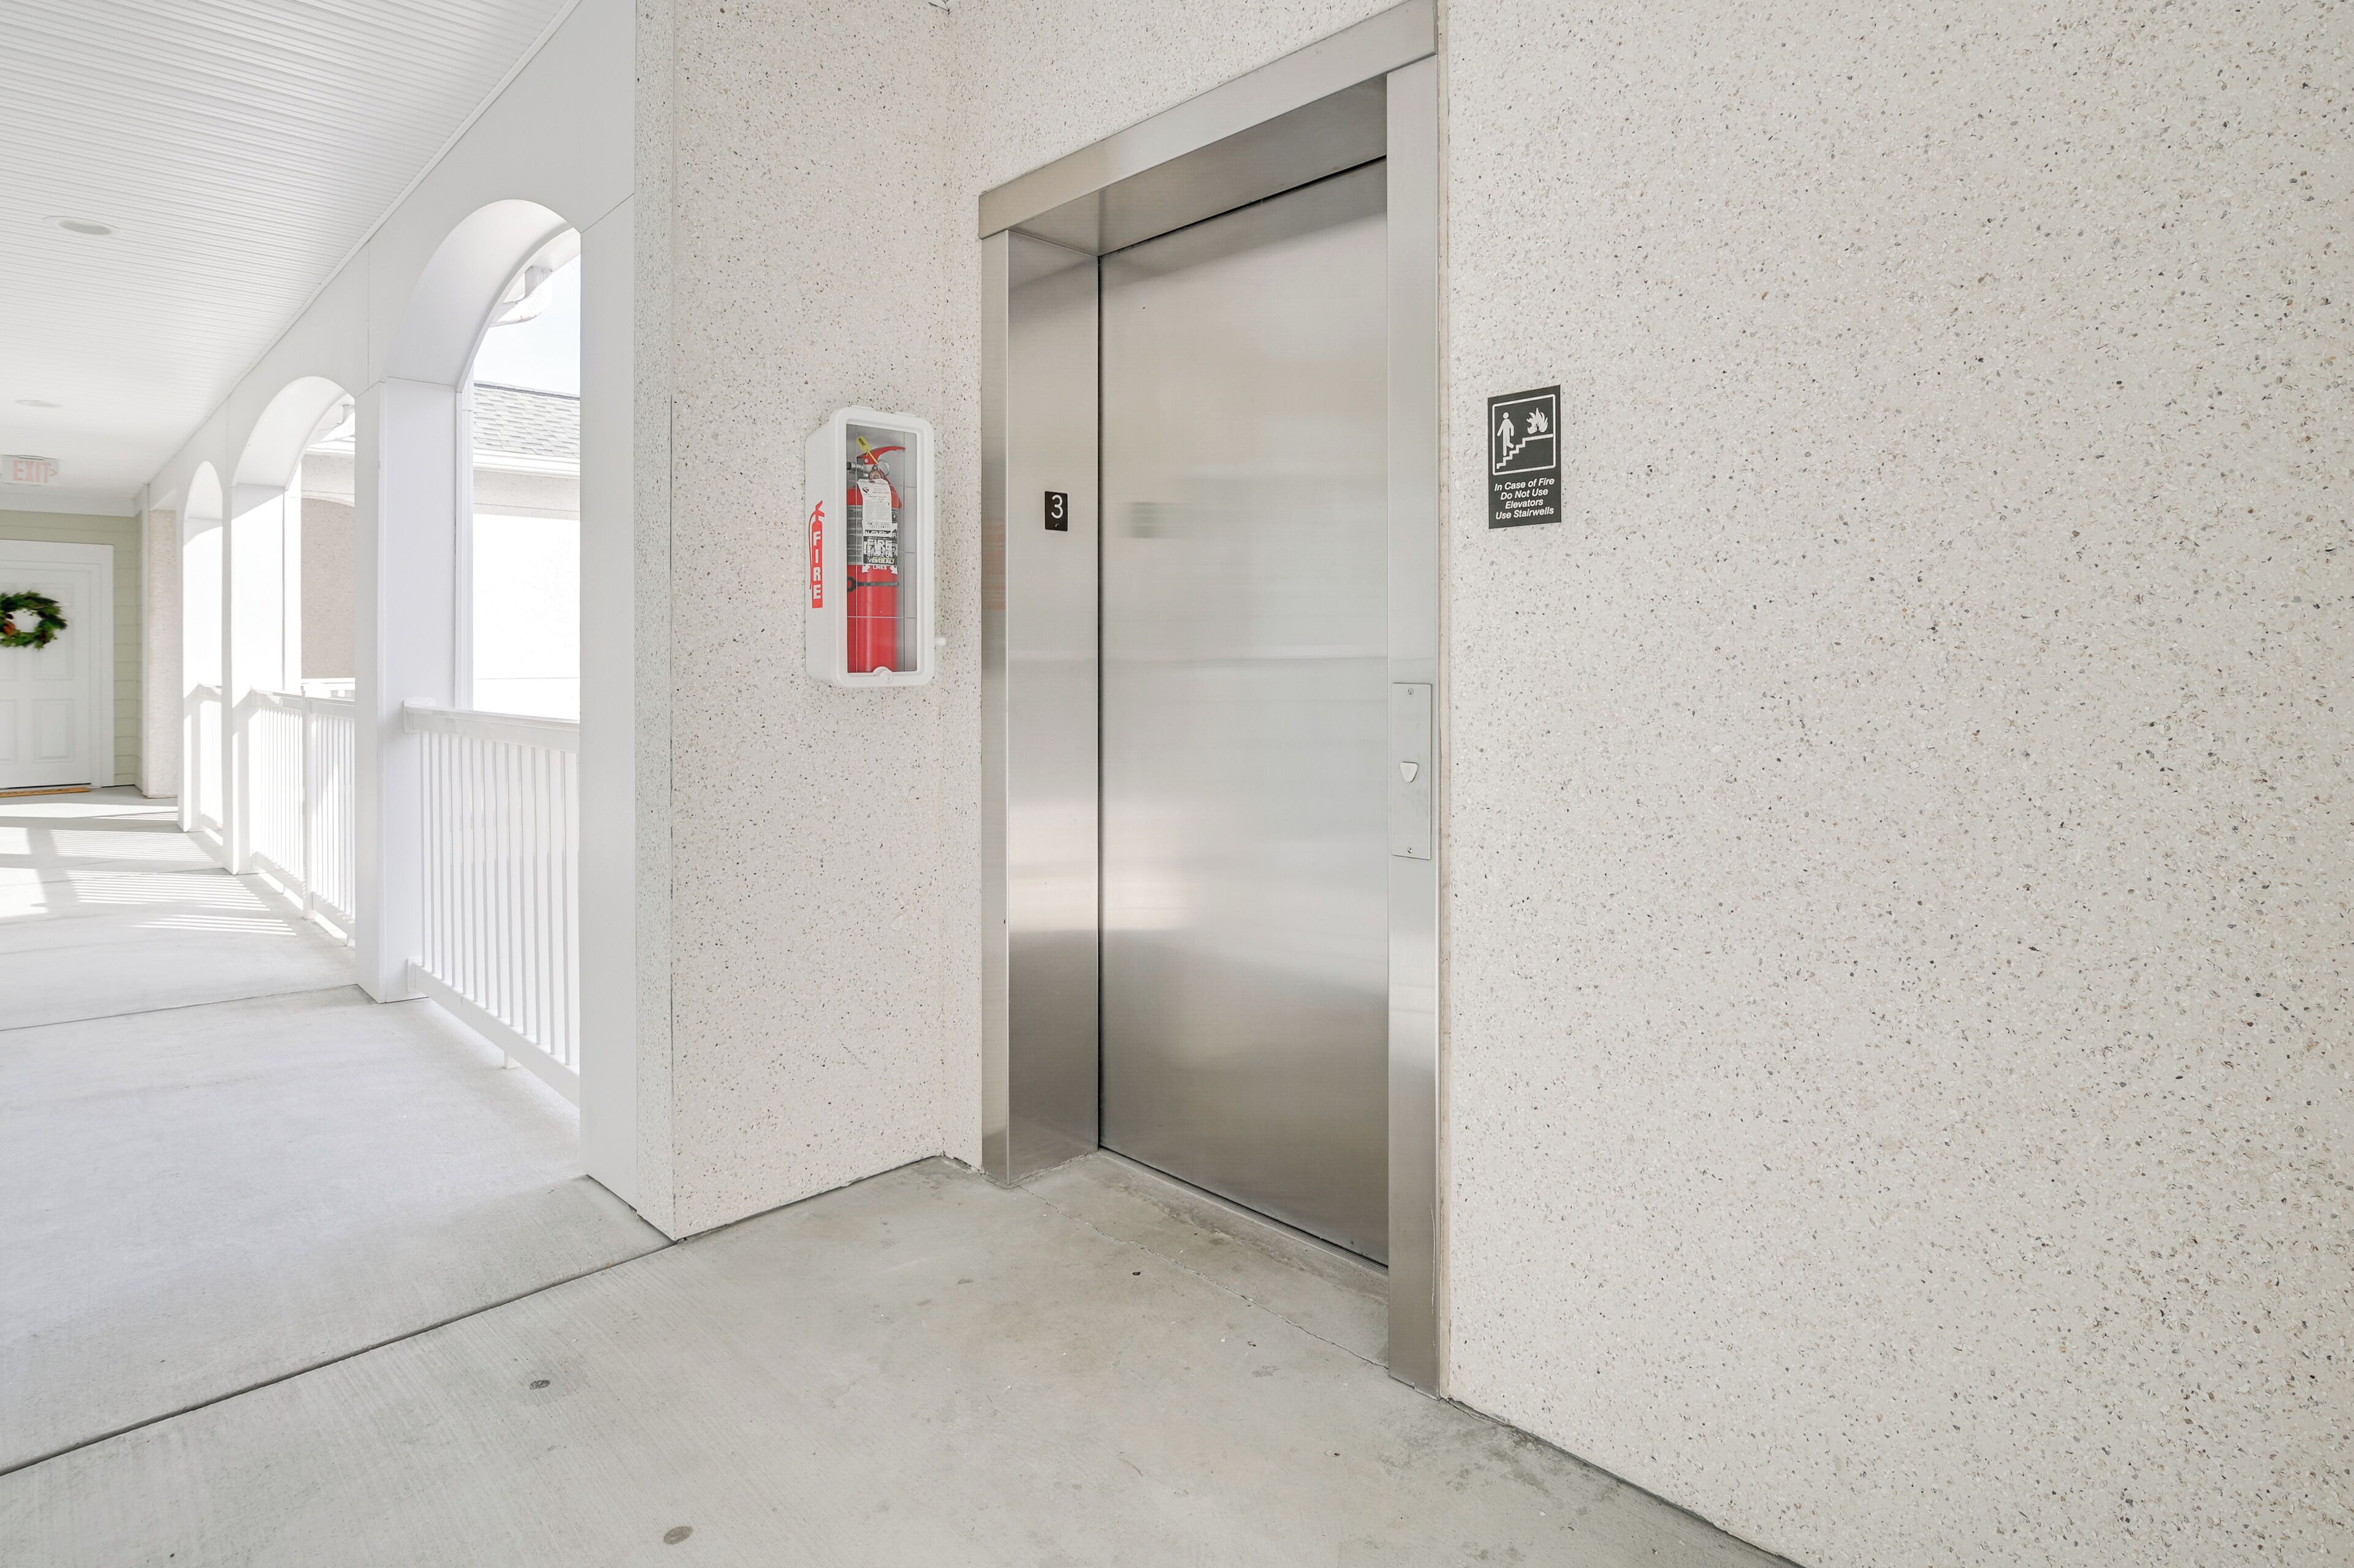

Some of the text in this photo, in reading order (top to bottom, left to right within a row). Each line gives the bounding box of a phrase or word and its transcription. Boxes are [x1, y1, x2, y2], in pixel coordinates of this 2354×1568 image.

[13, 460, 51, 482] EXIT
[1528, 479, 1537, 487] of
[1538, 478, 1555, 486] Fire
[1514, 490, 1530, 498] Not
[1532, 488, 1548, 497] Use
[1051, 494, 1064, 519] 3
[1505, 499, 1544, 509] Elevators
[1496, 506, 1554, 520] Use Stairwells
[813, 531, 821, 599] FIRE
